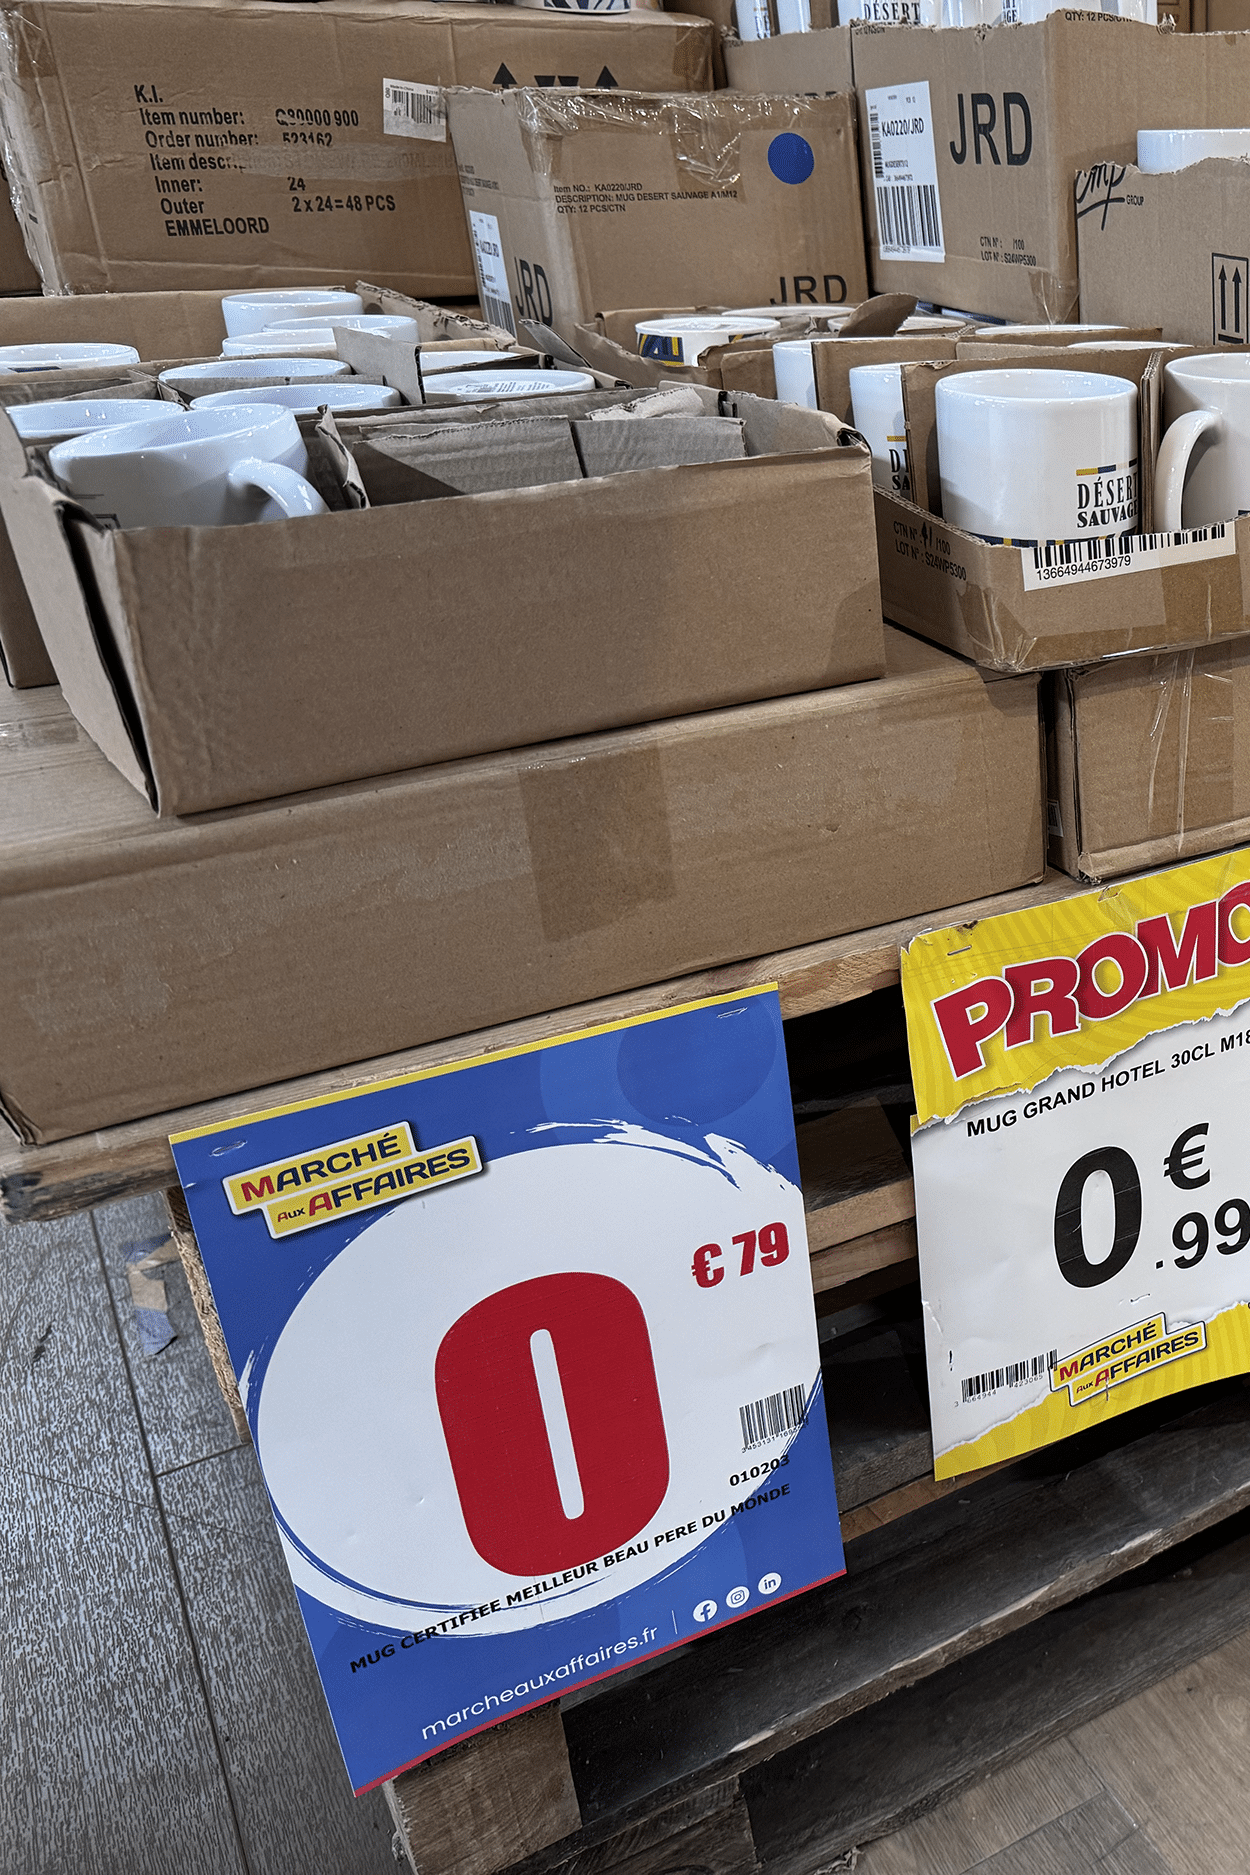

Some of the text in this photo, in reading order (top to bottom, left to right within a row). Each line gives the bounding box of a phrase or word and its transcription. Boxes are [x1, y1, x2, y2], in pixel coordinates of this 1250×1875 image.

[134, 84, 163, 103] K.I.
[140, 108, 176, 126] Item
[180, 108, 244, 126] number:
[881, 117, 925, 137] KA0220/JRD
[949, 92, 1032, 166] JRD
[145, 130, 192, 148] Order
[195, 131, 259, 148] number:
[149, 153, 185, 171] Item
[155, 175, 306, 193] Inner: 24
[554, 183, 643, 193] Item NO.: KA0220/JRD
[555, 190, 737, 203] DESCRIPTION: MUG DESERT SAUVAGE A1/M12
[160, 198, 205, 215] Outer
[292, 196, 302, 212] 2
[366, 194, 396, 211] PCS
[557, 204, 626, 214] QTY: 12 PCS/CTN
[1127, 195, 1144, 206] GROUP
[165, 216, 270, 236] EMMELOORD
[514, 256, 553, 326] JRD
[770, 274, 848, 303] JRD
[893, 521, 908, 538] CTN
[895, 538, 967, 581] LOT S24WP5300
[1037, 555, 1131, 580] 13664944673979
[966, 1109, 1017, 1138] MUG
[1022, 1081, 1095, 1120] GRAND
[1101, 1059, 1166, 1099] HOTEL
[1170, 1044, 1216, 1069] 30CL
[240, 1133, 402, 1202] MARCHÉ
[1163, 1122, 1211, 1190] €
[277, 1148, 471, 1223] Aux AFFAIRES
[1053, 1145, 1143, 1288] 0
[1060, 1321, 1157, 1381] MARCHÉ
[1095, 1331, 1199, 1387] AFFAIRES
[434, 1272, 671, 1577] 0
[729, 1455, 791, 1487] 010203
[349, 1483, 791, 1674] MUG CERTIFIEE MEILLEUR BEAU PERE DU MONDE
[422, 1625, 658, 1741] marcheauxaffaires.fr
